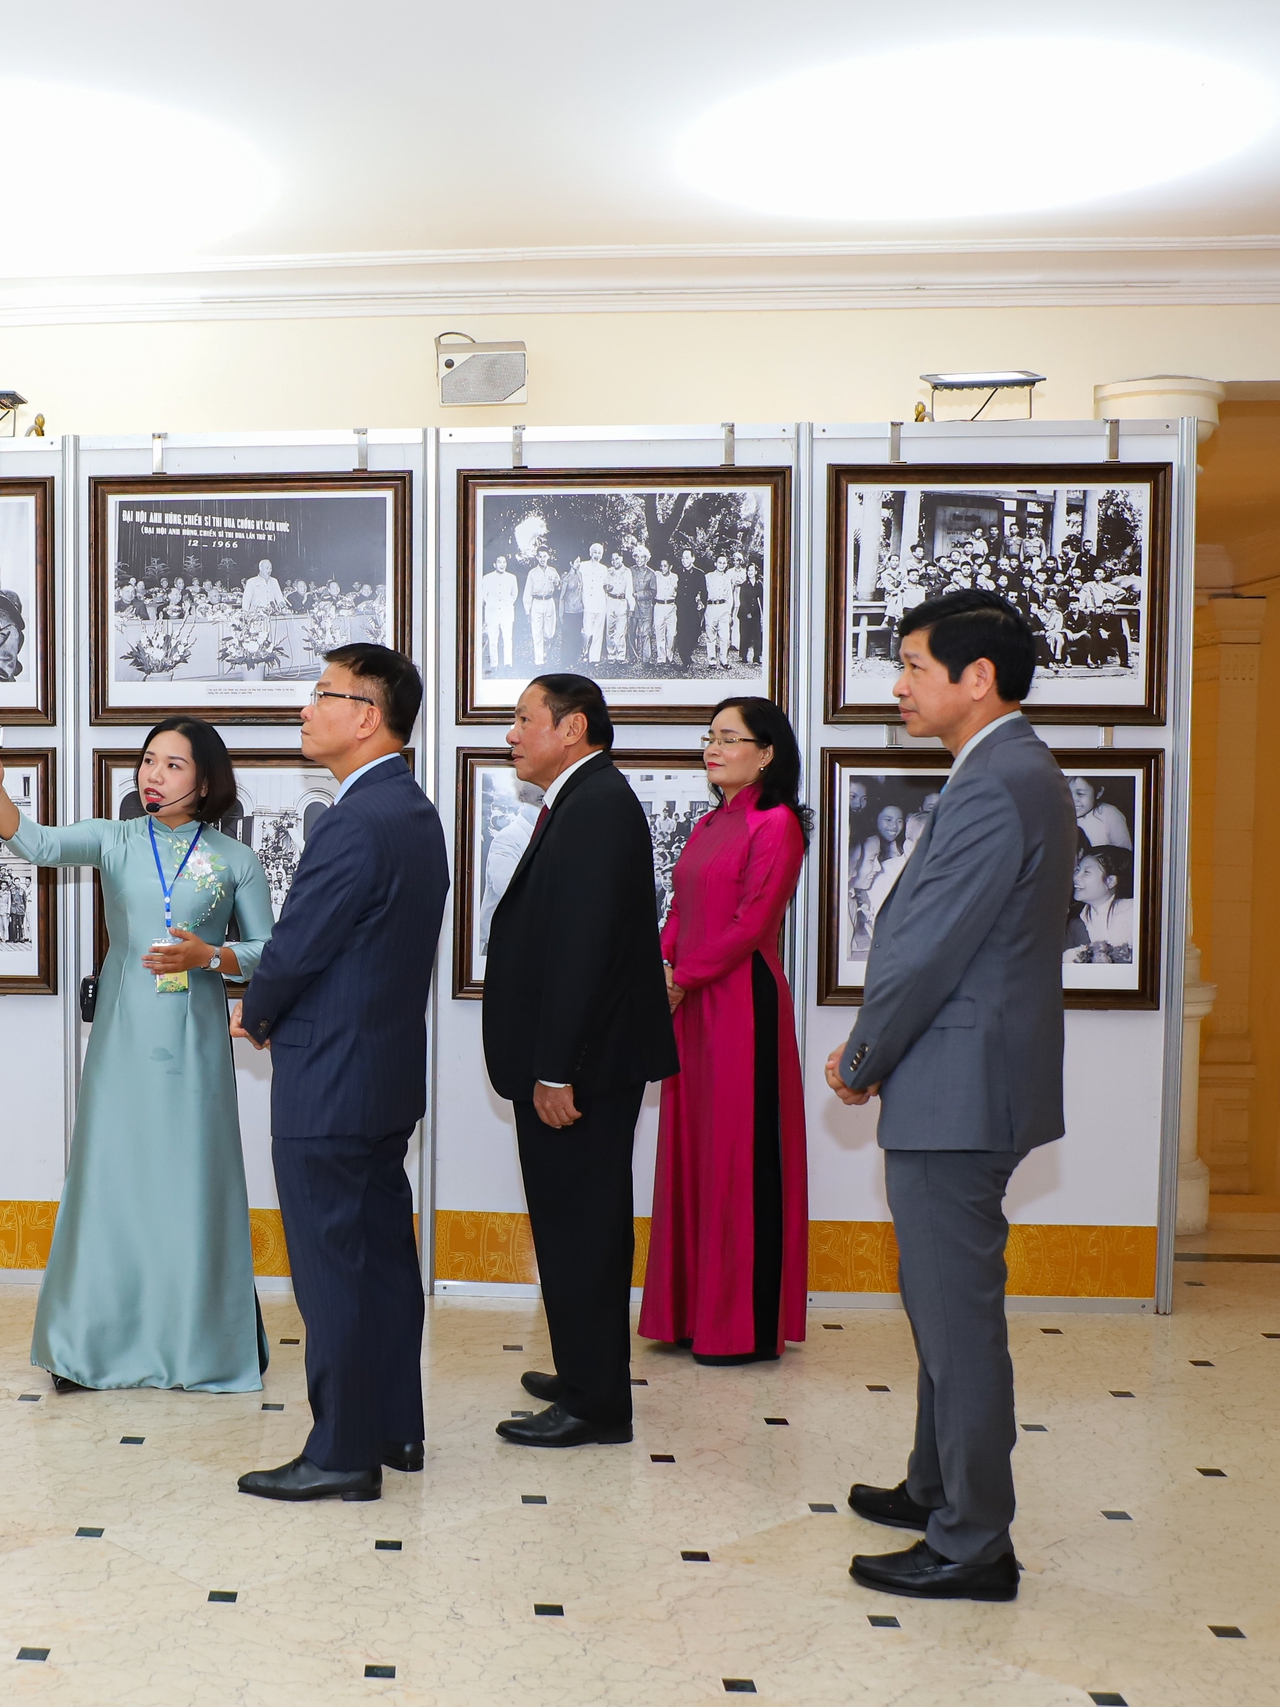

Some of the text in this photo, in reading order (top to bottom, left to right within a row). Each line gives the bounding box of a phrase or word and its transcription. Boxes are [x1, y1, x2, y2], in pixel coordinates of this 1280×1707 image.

[122, 510, 133, 523] ĐẠI
[135, 510, 147, 524] HỘI
[149, 512, 162, 524] ANH
[212, 516, 222, 528] THI
[223, 517, 236, 529] ĐUA
[236, 517, 254, 530] CHỐNG
[155, 527, 167, 536] HỘI
[225, 531, 234, 539] THI
